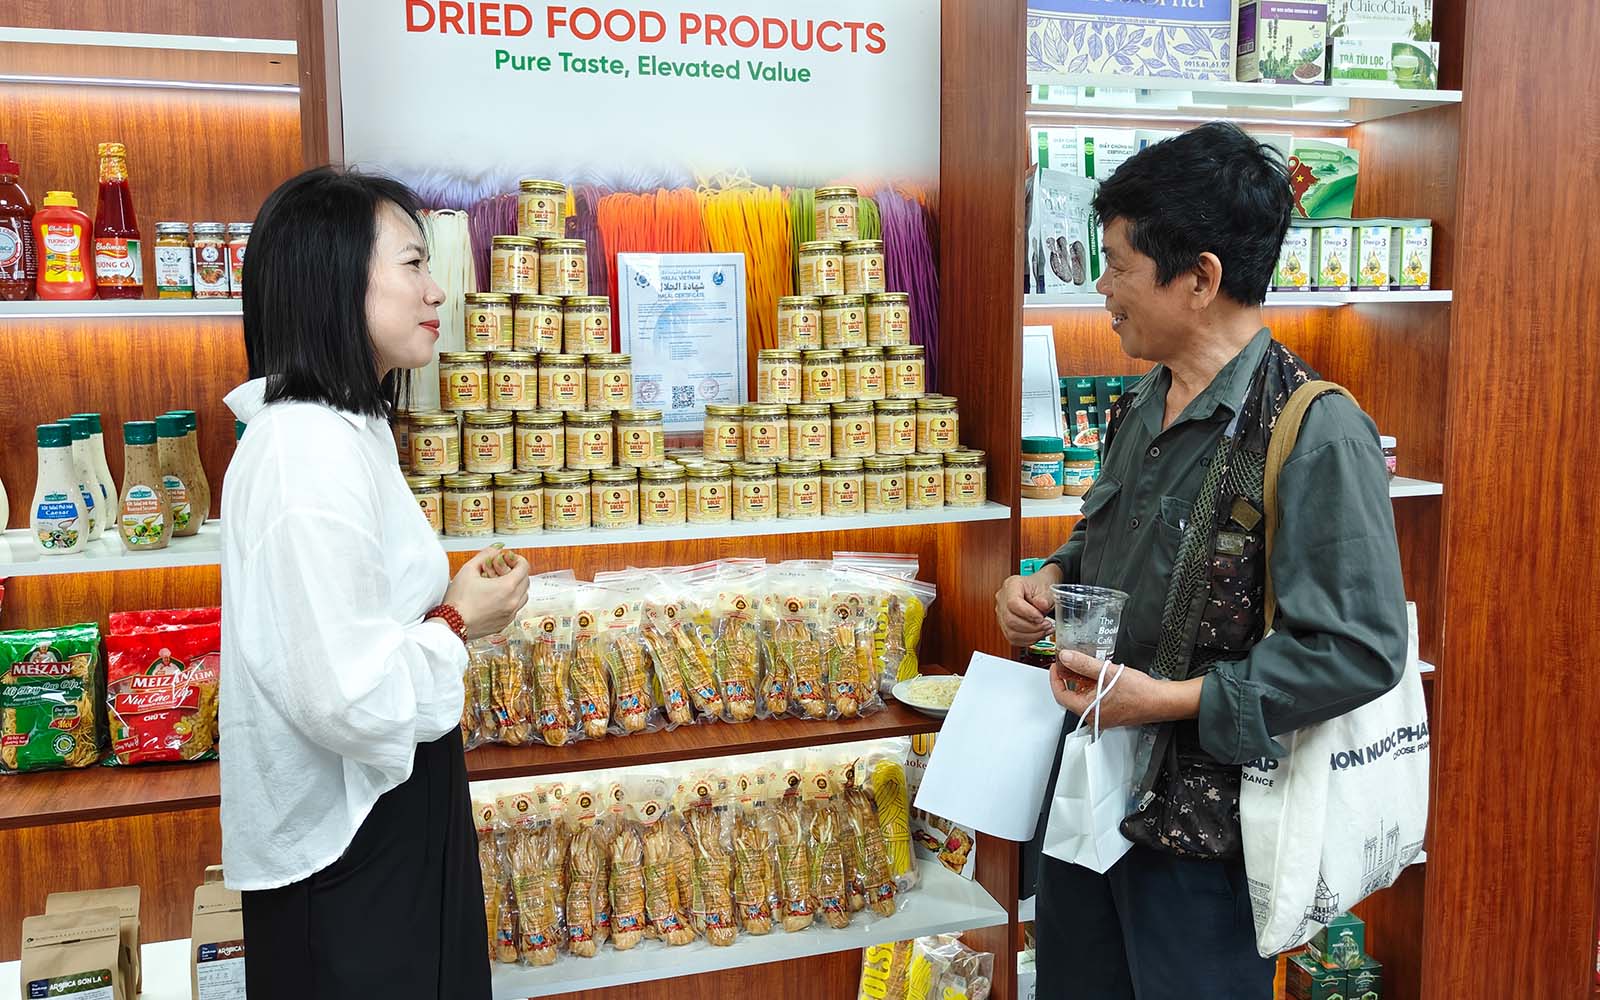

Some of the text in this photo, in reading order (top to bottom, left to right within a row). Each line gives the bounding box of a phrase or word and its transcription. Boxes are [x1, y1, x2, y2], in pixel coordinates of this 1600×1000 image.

[406, 0, 887, 54] DRIED FOOD PRODUCTS
[495, 50, 812, 83] Pure Taste, Elevated Value
[1342, 239, 1348, 247] 3
[1382, 238, 1388, 247] 3
[1422, 238, 1428, 247] 3
[13, 664, 73, 675] MEIZAN
[1330, 749, 1364, 770] ON
